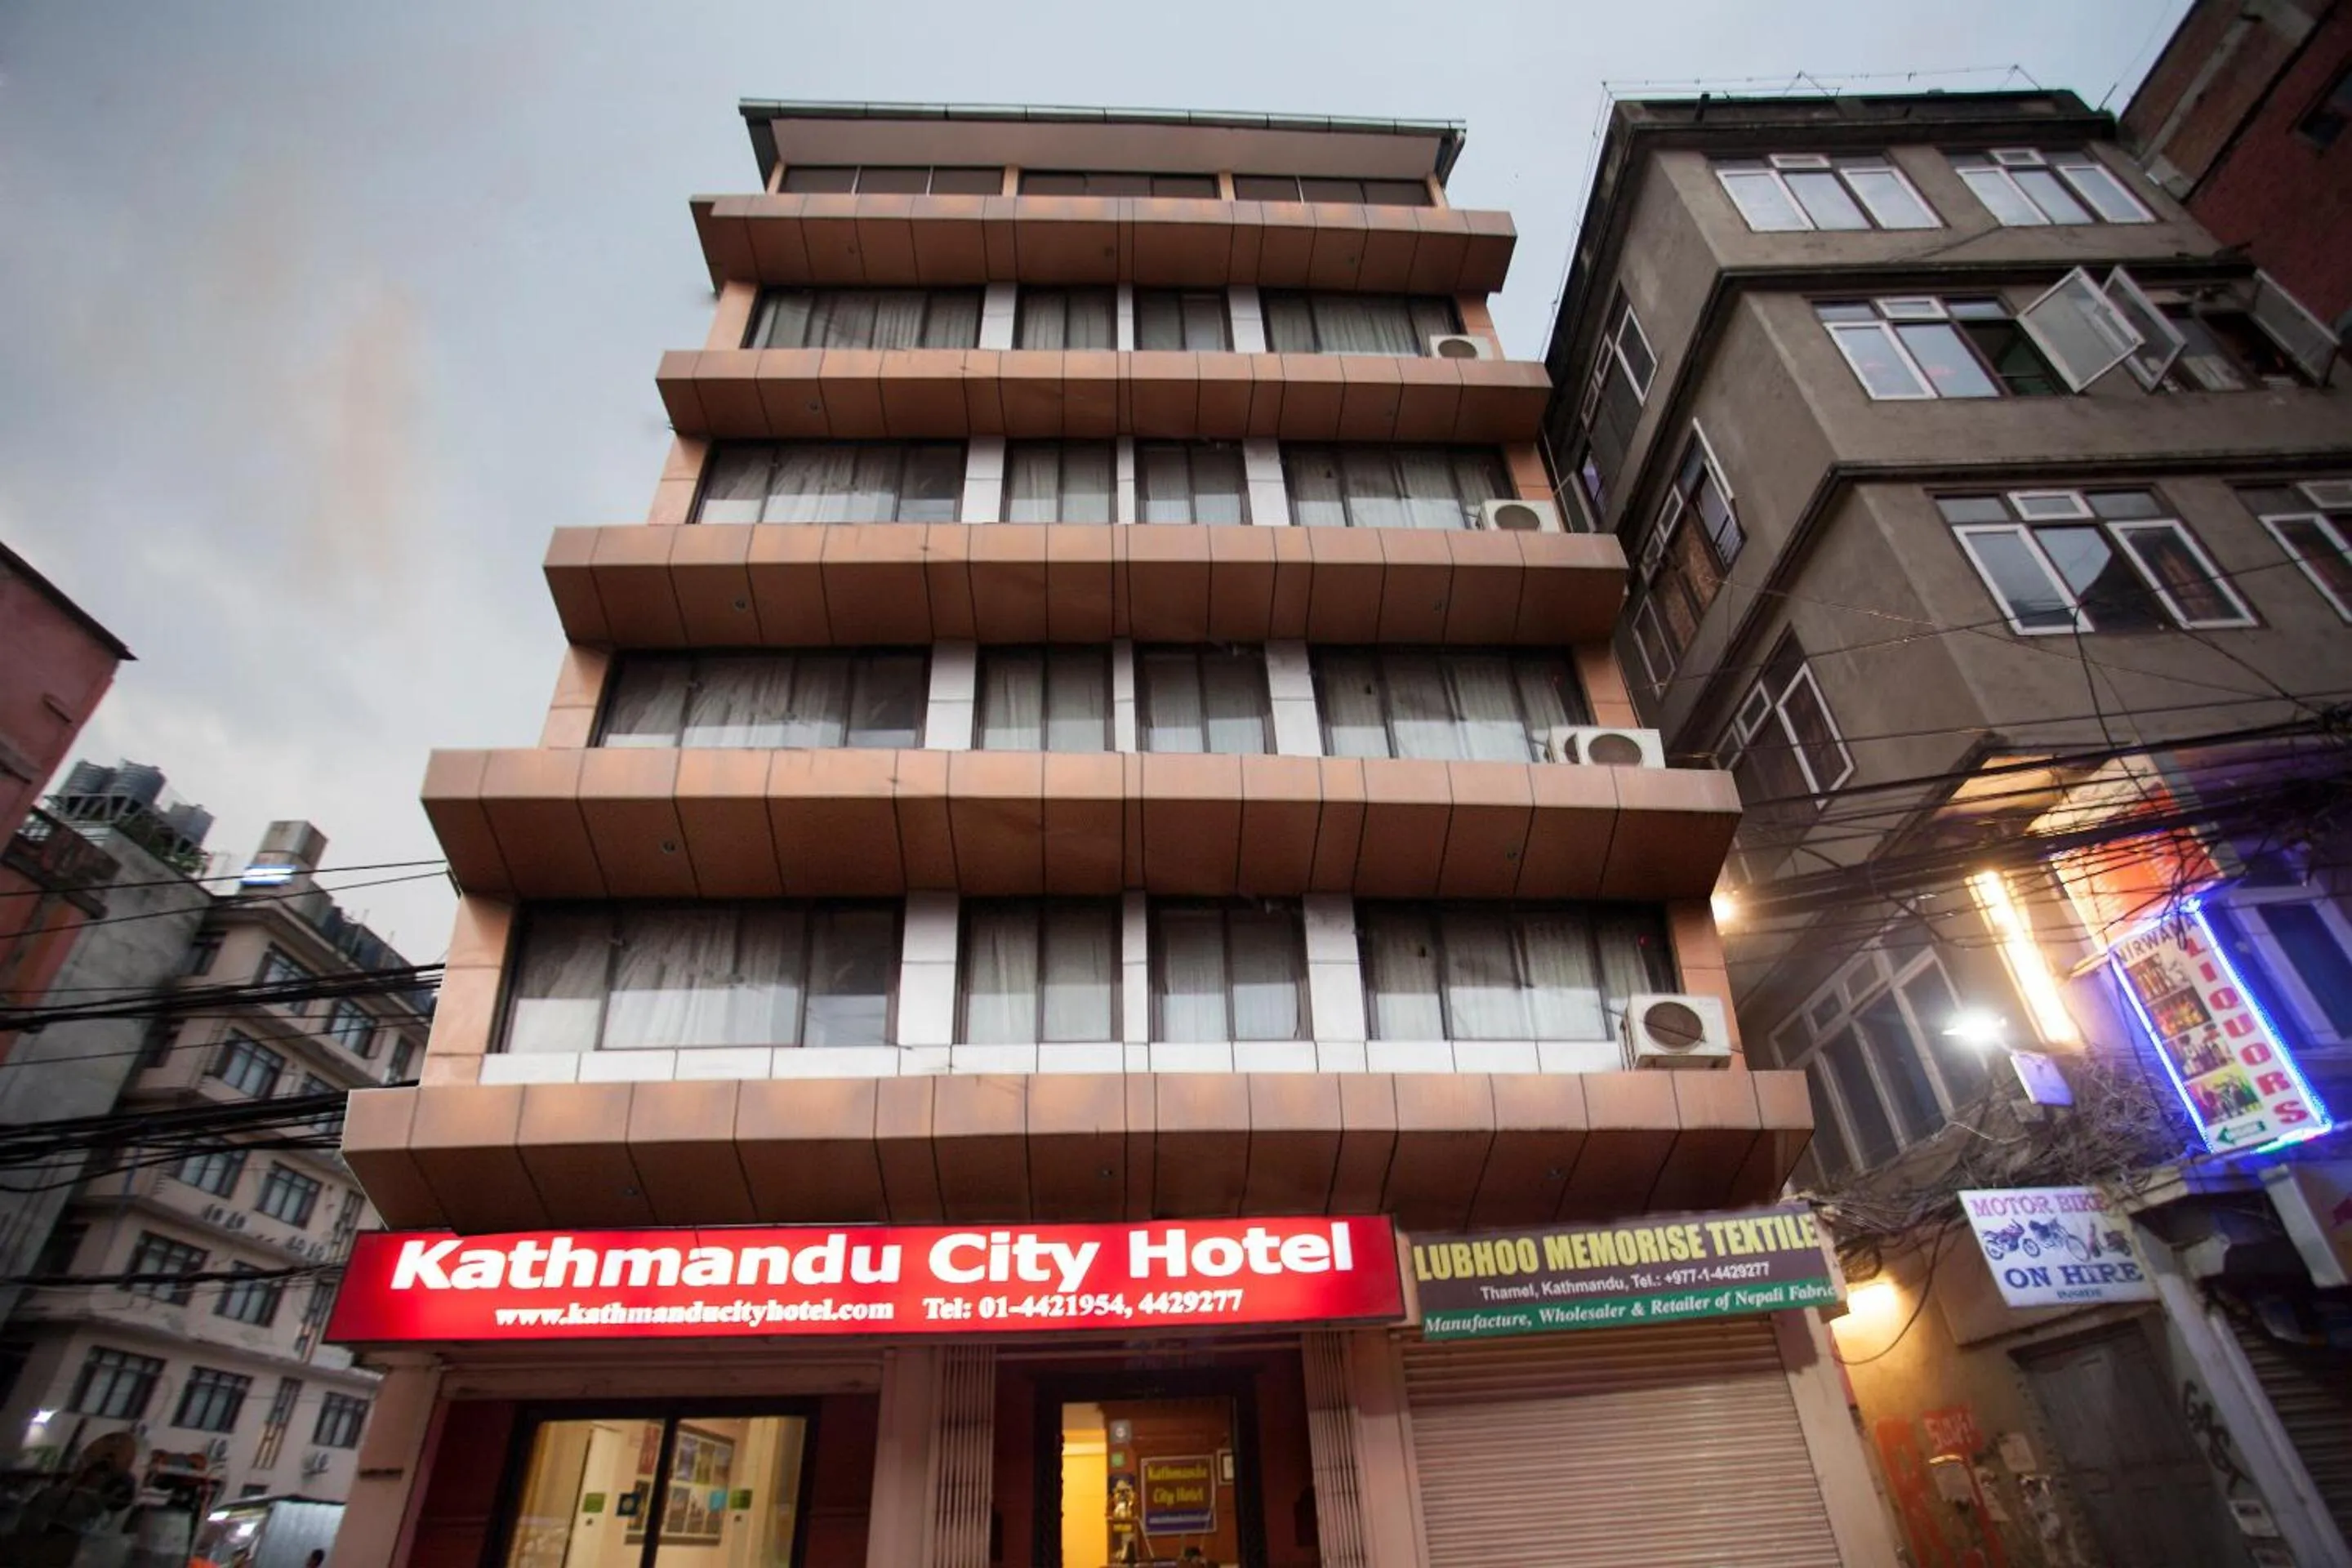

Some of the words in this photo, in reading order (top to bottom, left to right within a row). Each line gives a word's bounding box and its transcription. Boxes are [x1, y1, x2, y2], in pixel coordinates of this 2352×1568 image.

[2185, 938, 2309, 1125] LIQUORS
[1970, 1196, 2055, 1218] MOTOR
[2055, 1193, 2110, 1212] BIKE
[390, 1233, 902, 1290] Kathmandu
[929, 1231, 1102, 1293] City
[1129, 1222, 1353, 1279] Hotel
[1413, 1237, 1539, 1281] LUBHOO
[1543, 1223, 1707, 1272] MEMORISE
[1707, 1214, 1821, 1258] TEXTILE
[1480, 1283, 1539, 1301] Thamel,
[1541, 1276, 1628, 1296] Kathmandu,
[1633, 1272, 1662, 1289] Tel.:
[1664, 1260, 1771, 1286] +977-1-4429277
[2005, 1267, 2052, 1289] ON
[495, 1299, 894, 1328] www.kathmanducityhotel.com
[921, 1297, 973, 1320] Tel:
[978, 1294, 1134, 1319] 01-4421954,
[1138, 1288, 1245, 1314] 4429277
[1424, 1313, 1533, 1334] Manufacture,
[1539, 1303, 1626, 1325] Wholesaler
[1631, 1303, 1645, 1317] &
[1650, 1294, 1711, 1315] Retailer
[1714, 1290, 1731, 1310] of
[1735, 1285, 1784, 1307] Nepali
